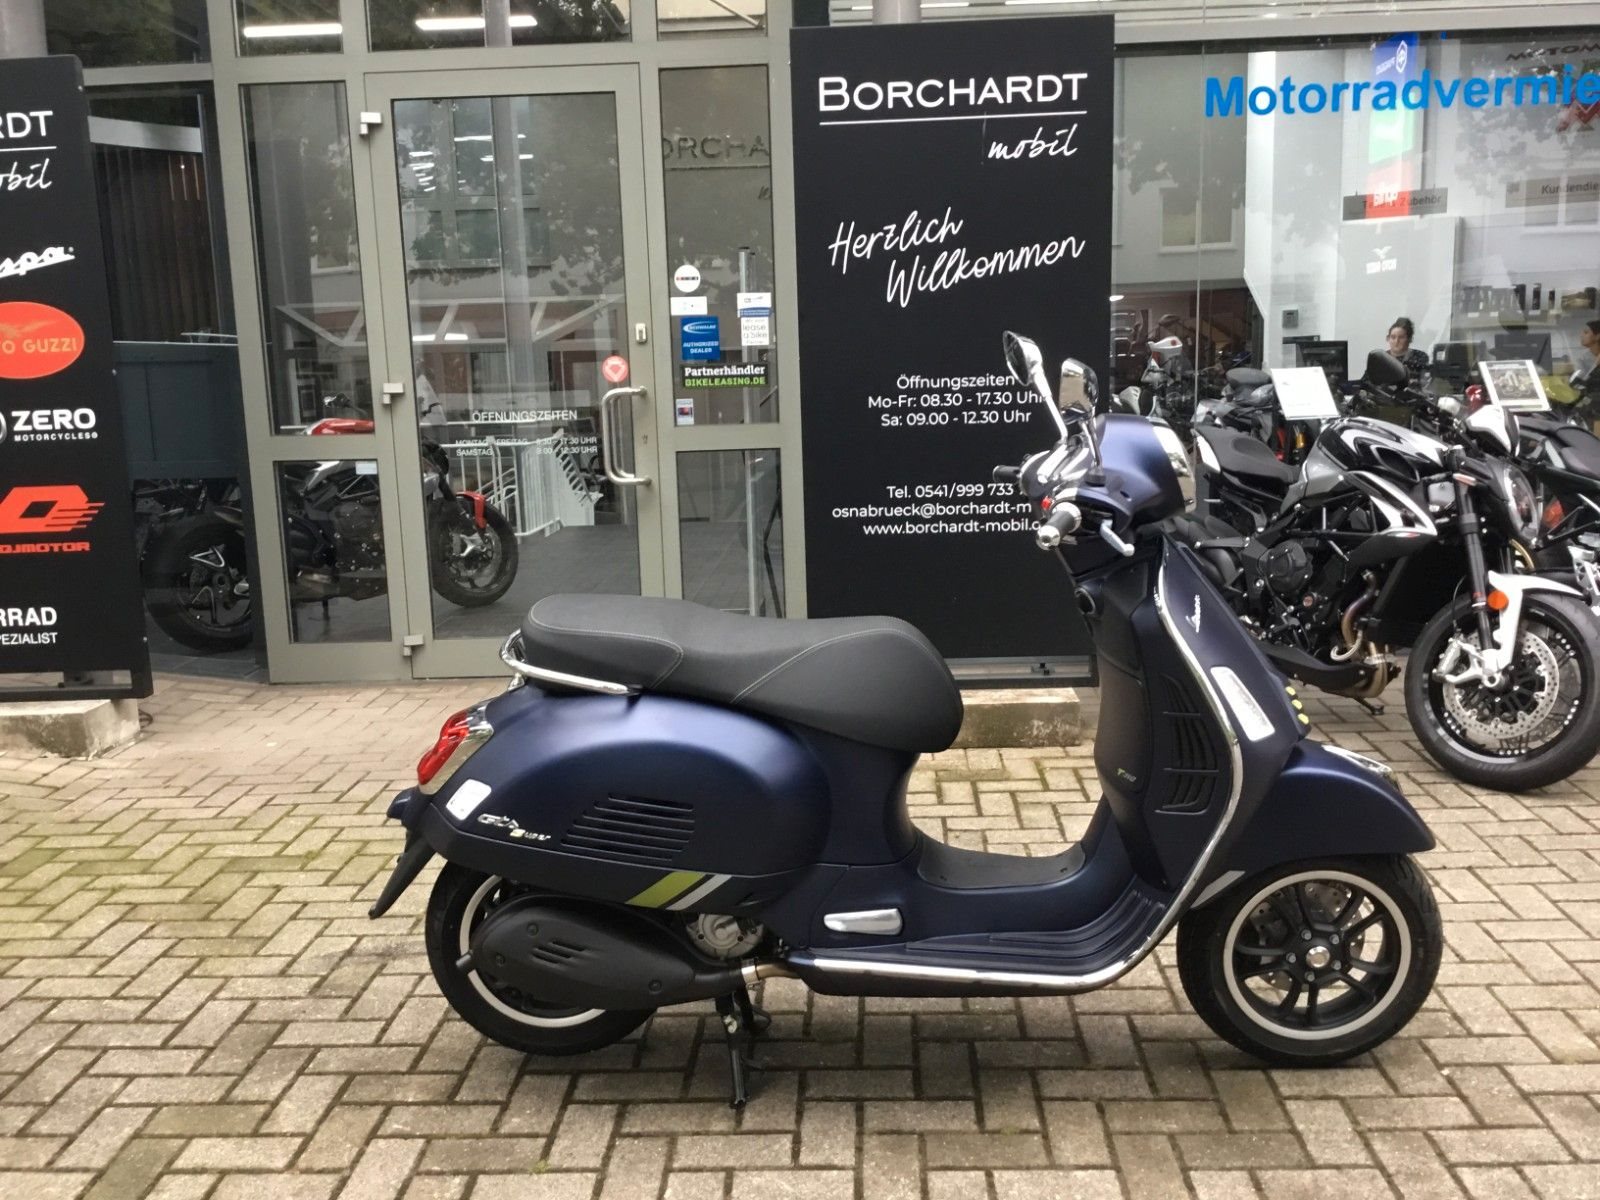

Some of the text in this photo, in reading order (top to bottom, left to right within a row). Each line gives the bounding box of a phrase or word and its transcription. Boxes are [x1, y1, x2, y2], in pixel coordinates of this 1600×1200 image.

[818, 73, 1088, 111] BORCHARDT
[1204, 63, 1600, 117] Motorradvermie
[0, 110, 53, 138] DT
[987, 123, 1078, 159] mobil
[828, 207, 964, 275] Herzlich
[886, 236, 1086, 308] Willkommen
[22, 337, 77, 353] GUZZI
[684, 365, 766, 377] Partnerhändler
[684, 377, 766, 388] BIKELEASING.DE
[896, 373, 1015, 391] Öffnungszeiten
[868, 395, 917, 408] Mo-Fr:
[920, 393, 963, 407] 08.30
[976, 392, 1013, 406] 17.30
[11, 408, 96, 431] ZERO
[472, 409, 577, 421] ÖFFNUNGSZEITEN
[881, 413, 903, 427] Sa:
[906, 412, 949, 426] 09.00
[962, 410, 999, 424] 12.30
[1003, 410, 1032, 423] Uhr
[886, 486, 911, 499] Tel.
[915, 482, 984, 499] 0541/999
[988, 483, 1014, 496] 733
[832, 501, 1032, 519] osnabrueck@borchardt-m
